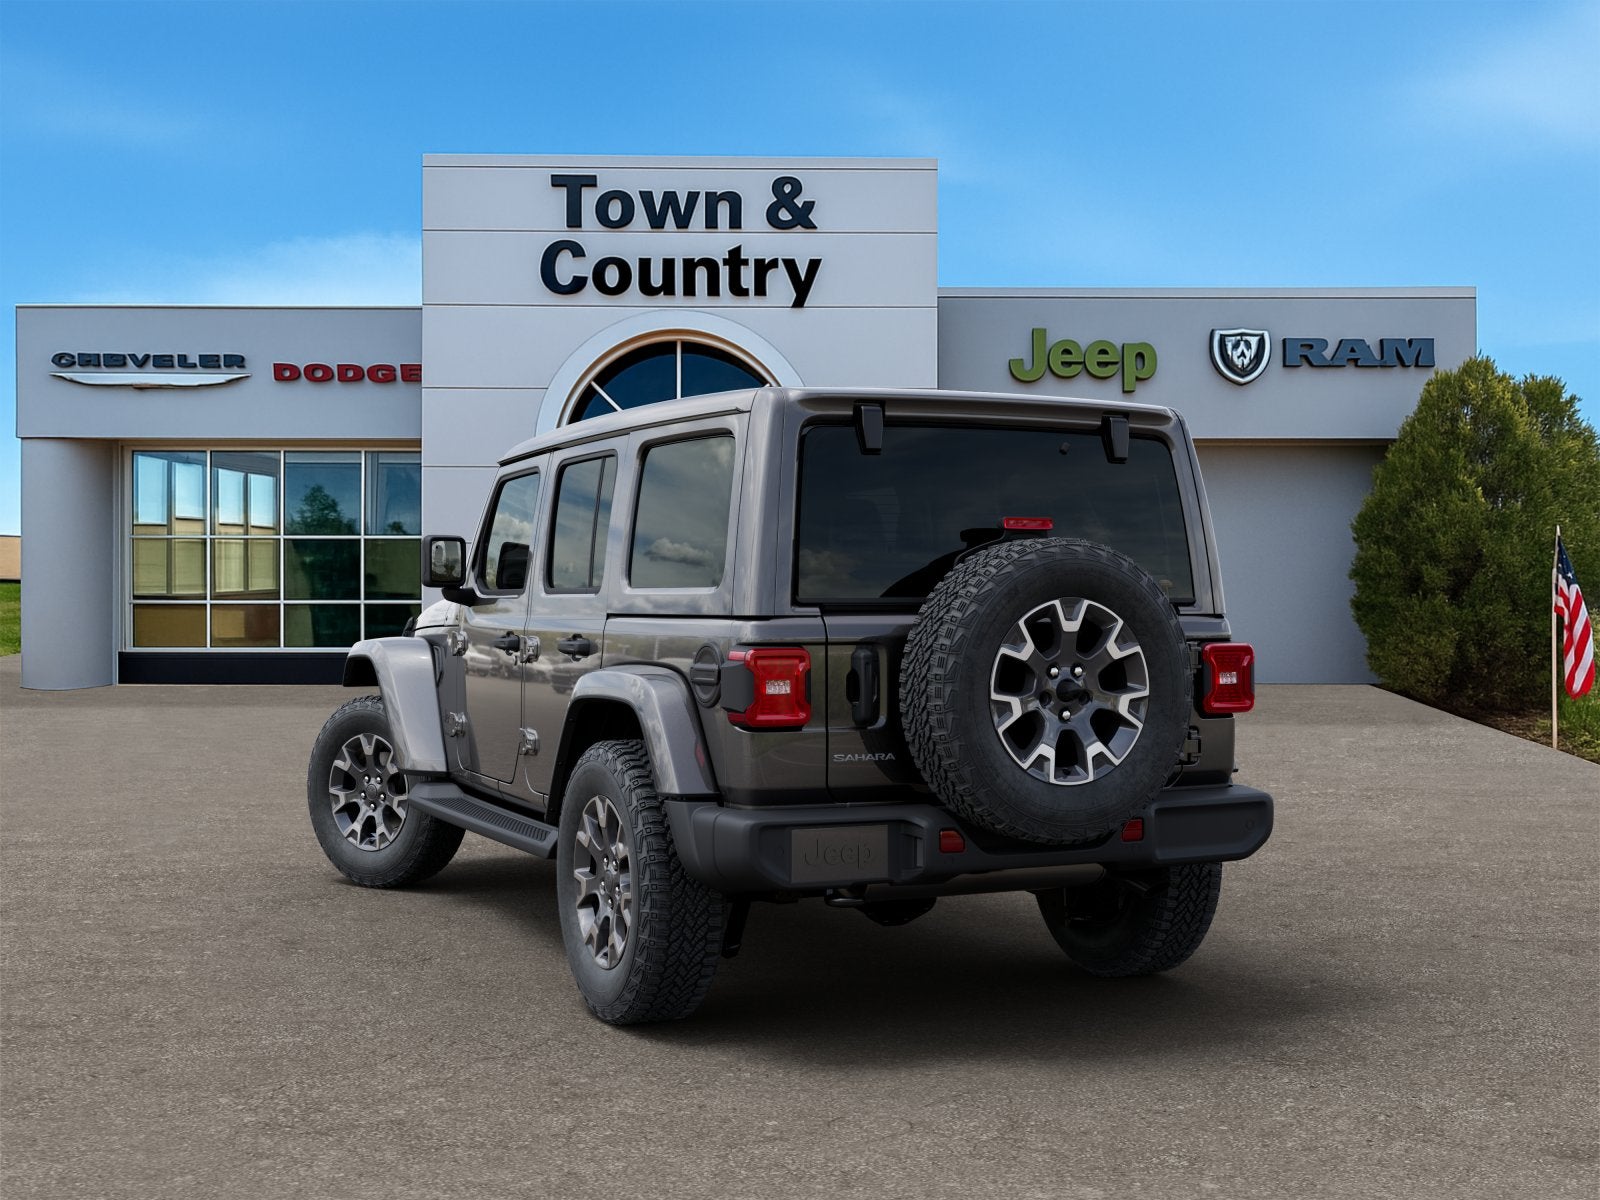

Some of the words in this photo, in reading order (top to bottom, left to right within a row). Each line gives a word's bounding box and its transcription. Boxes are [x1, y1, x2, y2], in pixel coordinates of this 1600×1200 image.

[551, 174, 742, 229] Town
[766, 176, 818, 230] &
[540, 239, 822, 308] Country
[1009, 328, 1157, 392] Jeep
[1282, 338, 1435, 368] RAM
[273, 363, 422, 383] DODGE
[833, 752, 896, 762] SAHARA
[804, 839, 873, 870] Jeep
